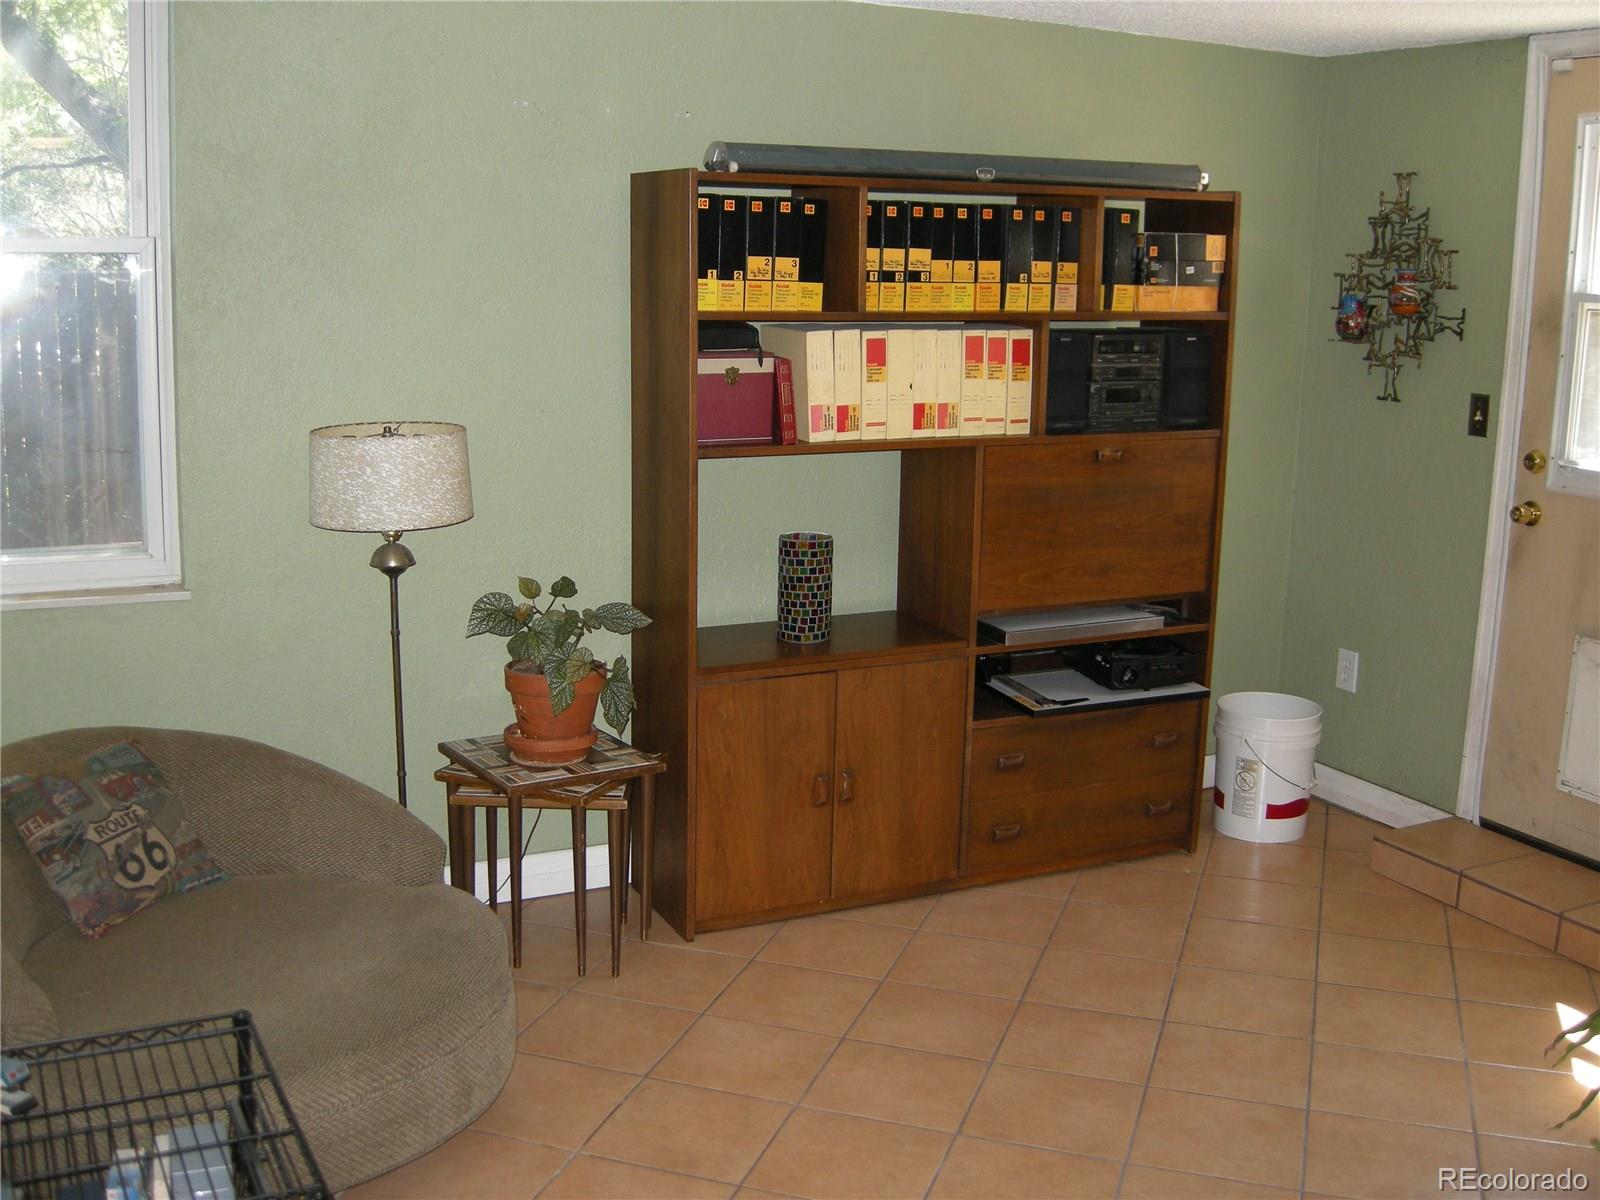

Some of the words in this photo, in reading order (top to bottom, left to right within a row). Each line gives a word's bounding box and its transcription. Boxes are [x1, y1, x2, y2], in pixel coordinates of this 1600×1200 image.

[764, 258, 770, 266] 2
[791, 259, 797, 268] 3
[968, 263, 974, 271] 2
[1059, 263, 1065, 271] 2
[1021, 274, 1026, 282] 4
[114, 831, 169, 882] 66
